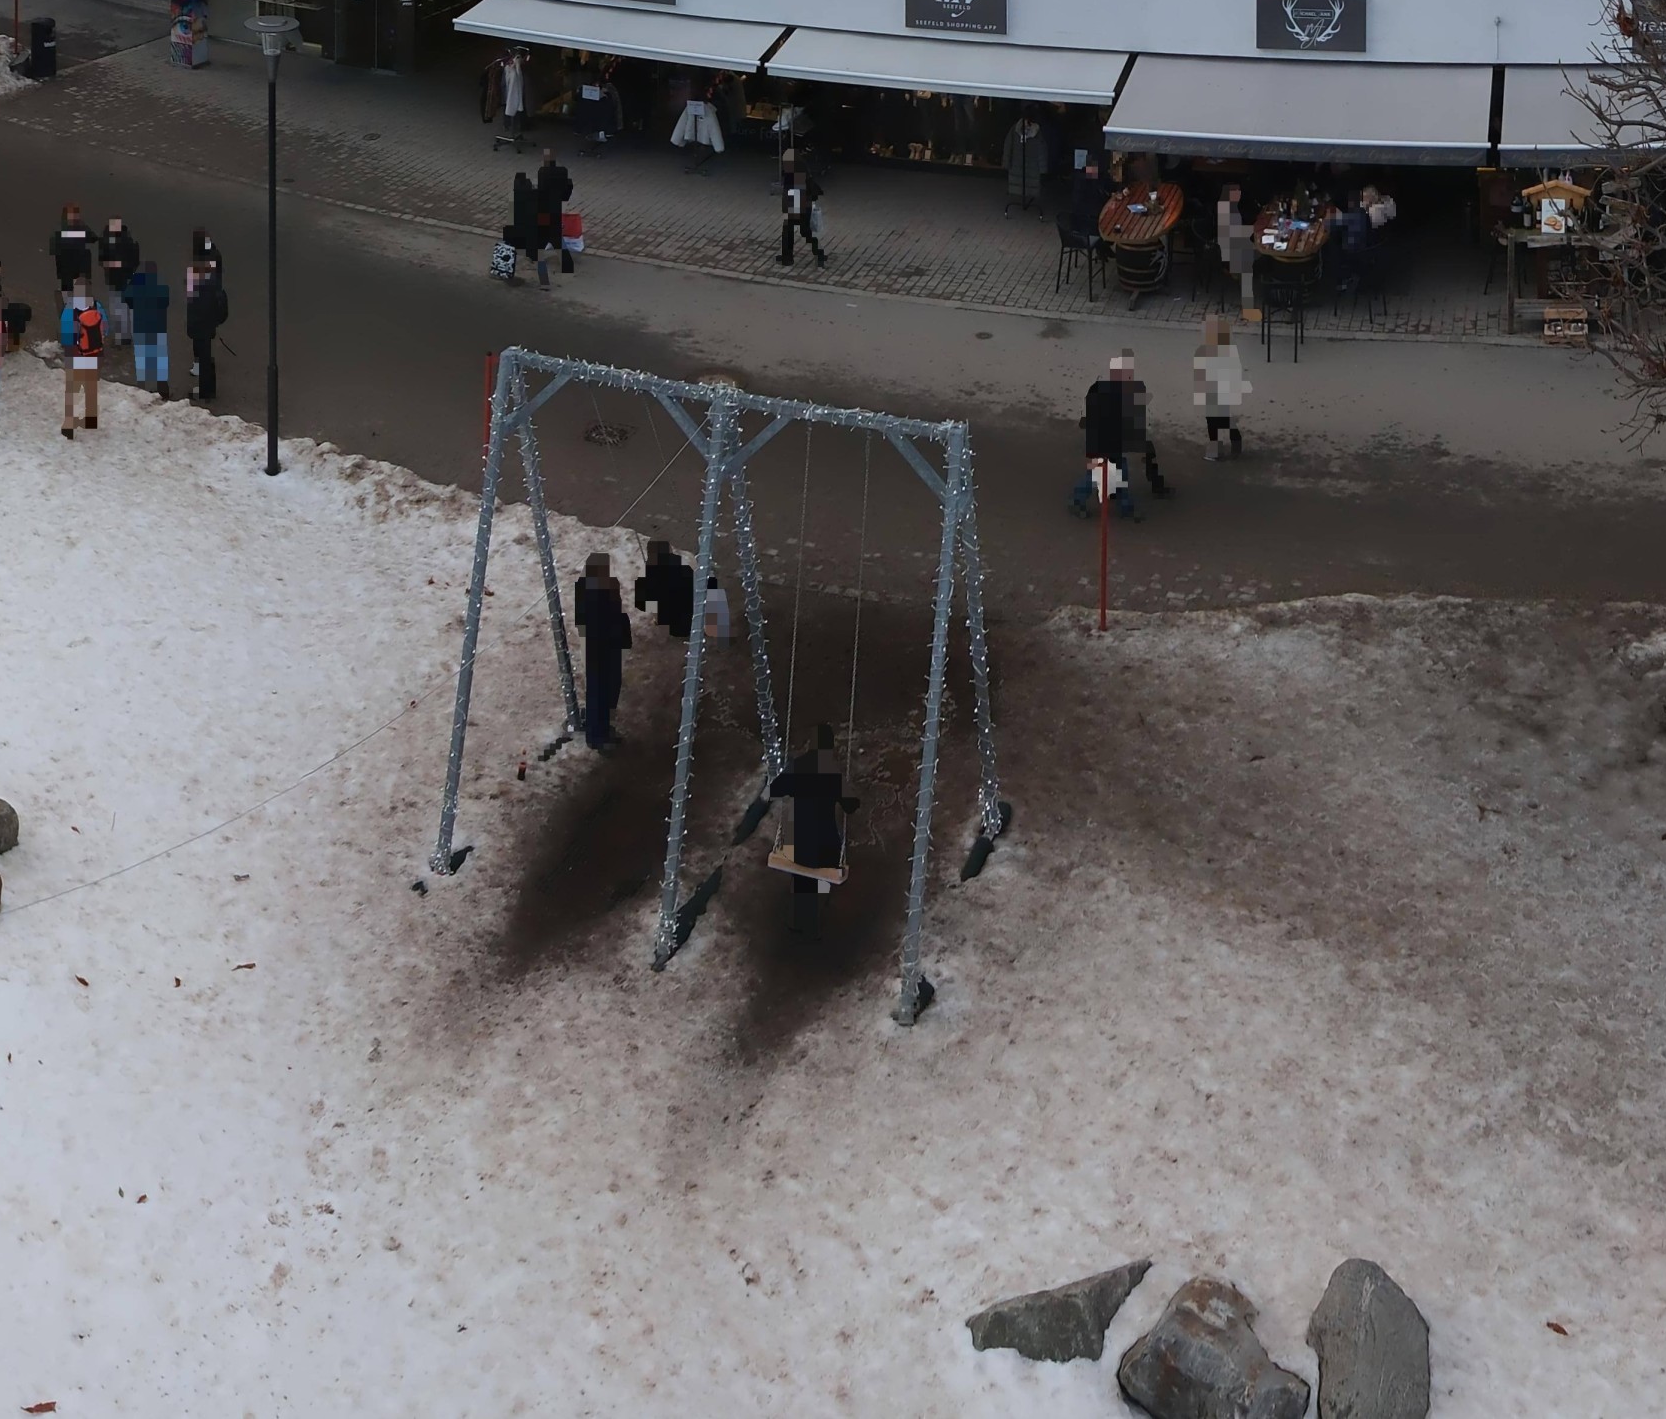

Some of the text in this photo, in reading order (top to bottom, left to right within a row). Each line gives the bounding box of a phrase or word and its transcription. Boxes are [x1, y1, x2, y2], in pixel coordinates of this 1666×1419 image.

[942, 3, 971, 11] SEEFELD
[915, 19, 944, 27] SEEFELD
[946, 21, 982, 30] SHOPPING
